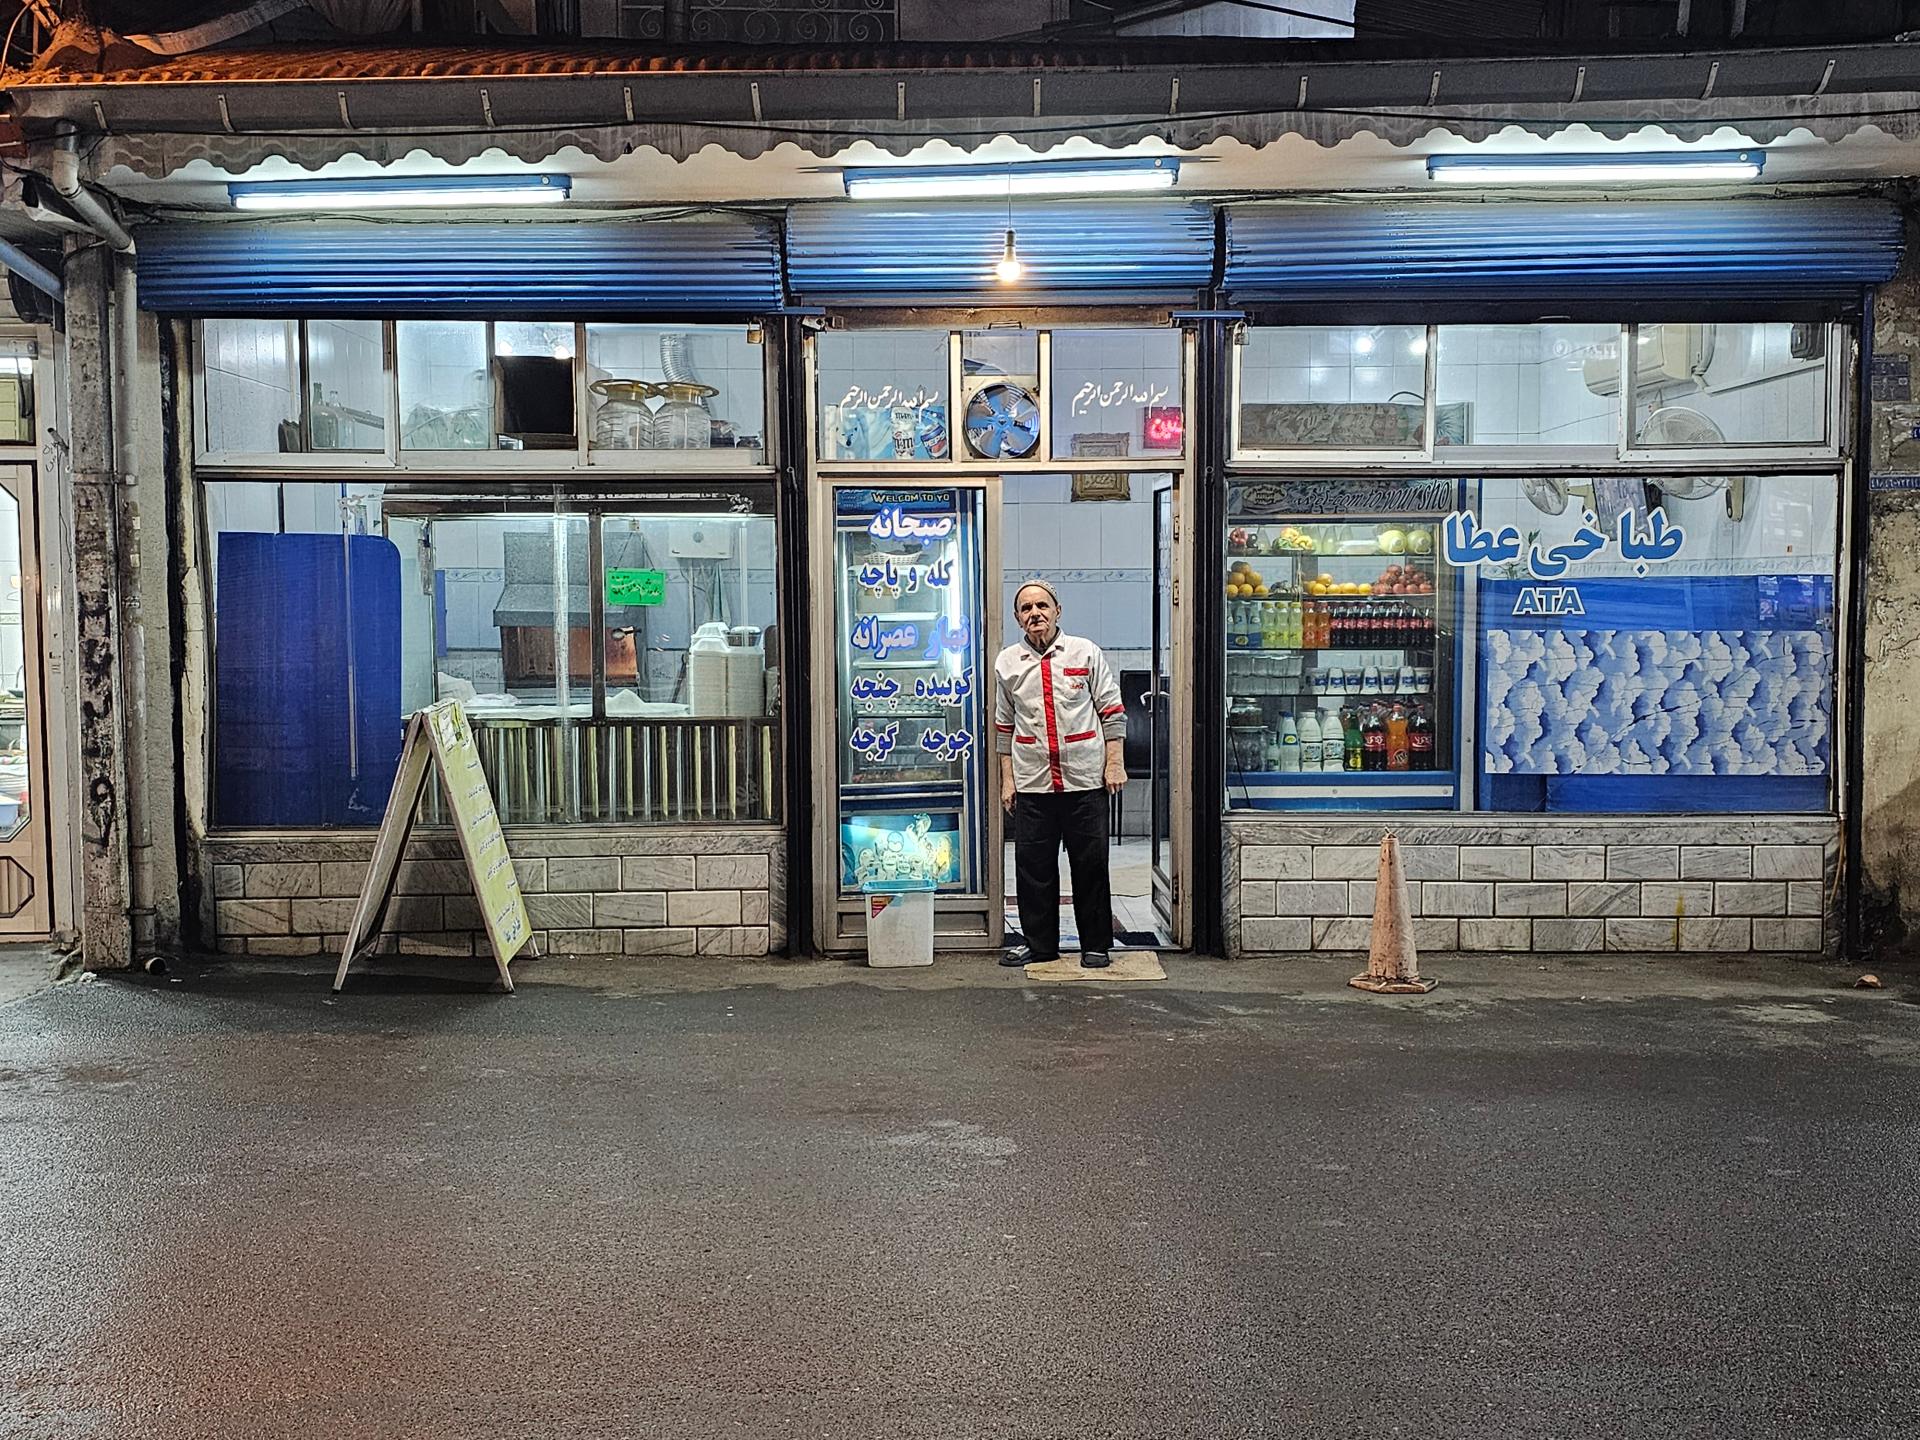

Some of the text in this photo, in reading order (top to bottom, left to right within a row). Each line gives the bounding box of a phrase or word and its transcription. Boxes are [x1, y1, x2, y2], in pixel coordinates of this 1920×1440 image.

[872, 492, 919, 504] WELCOM
[921, 493, 934, 502] TO
[936, 493, 950, 502] YO
[1363, 488, 1384, 508] to
[1381, 483, 1423, 513] your
[1417, 479, 1451, 511] sho
[869, 506, 954, 546] صبحانه
[1442, 509, 1524, 567] عطا
[858, 559, 955, 599] کله و پاچه
[1512, 586, 1586, 616] ATA
[849, 613, 971, 660] نهار عصرانه
[849, 667, 974, 713] کوبیده چنجه
[848, 720, 975, 762] جوجه گوجه
